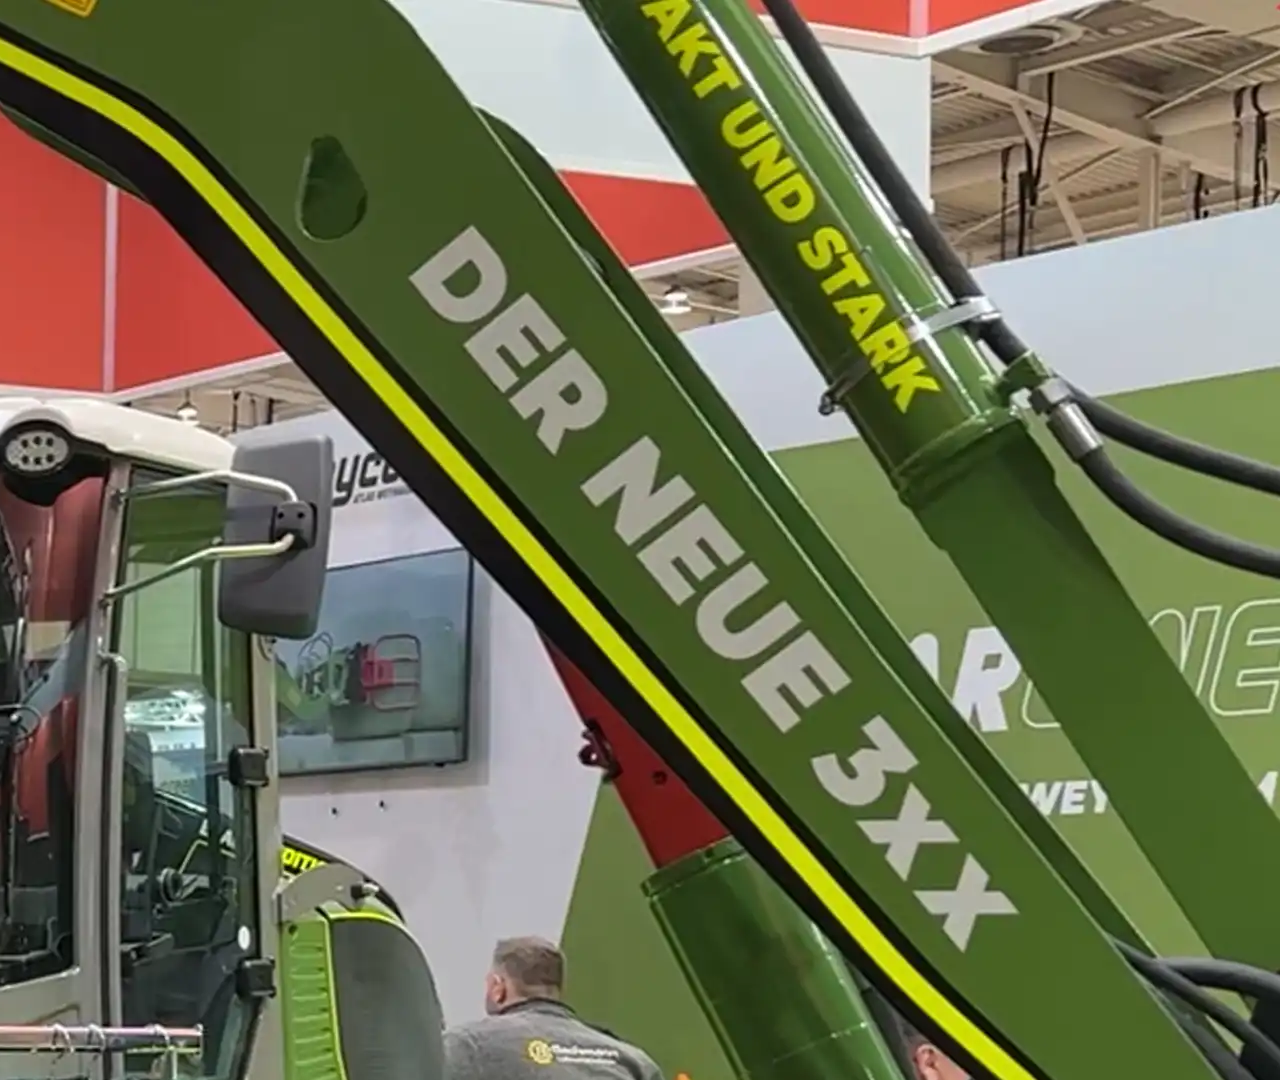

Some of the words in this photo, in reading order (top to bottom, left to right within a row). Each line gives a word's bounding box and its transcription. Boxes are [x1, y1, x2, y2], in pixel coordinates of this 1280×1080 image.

[722, 99, 816, 224] UND
[797, 226, 941, 414] STARK
[408, 225, 608, 457] DER
[580, 435, 852, 734] NEUE
[811, 714, 1020, 953] 3XX
